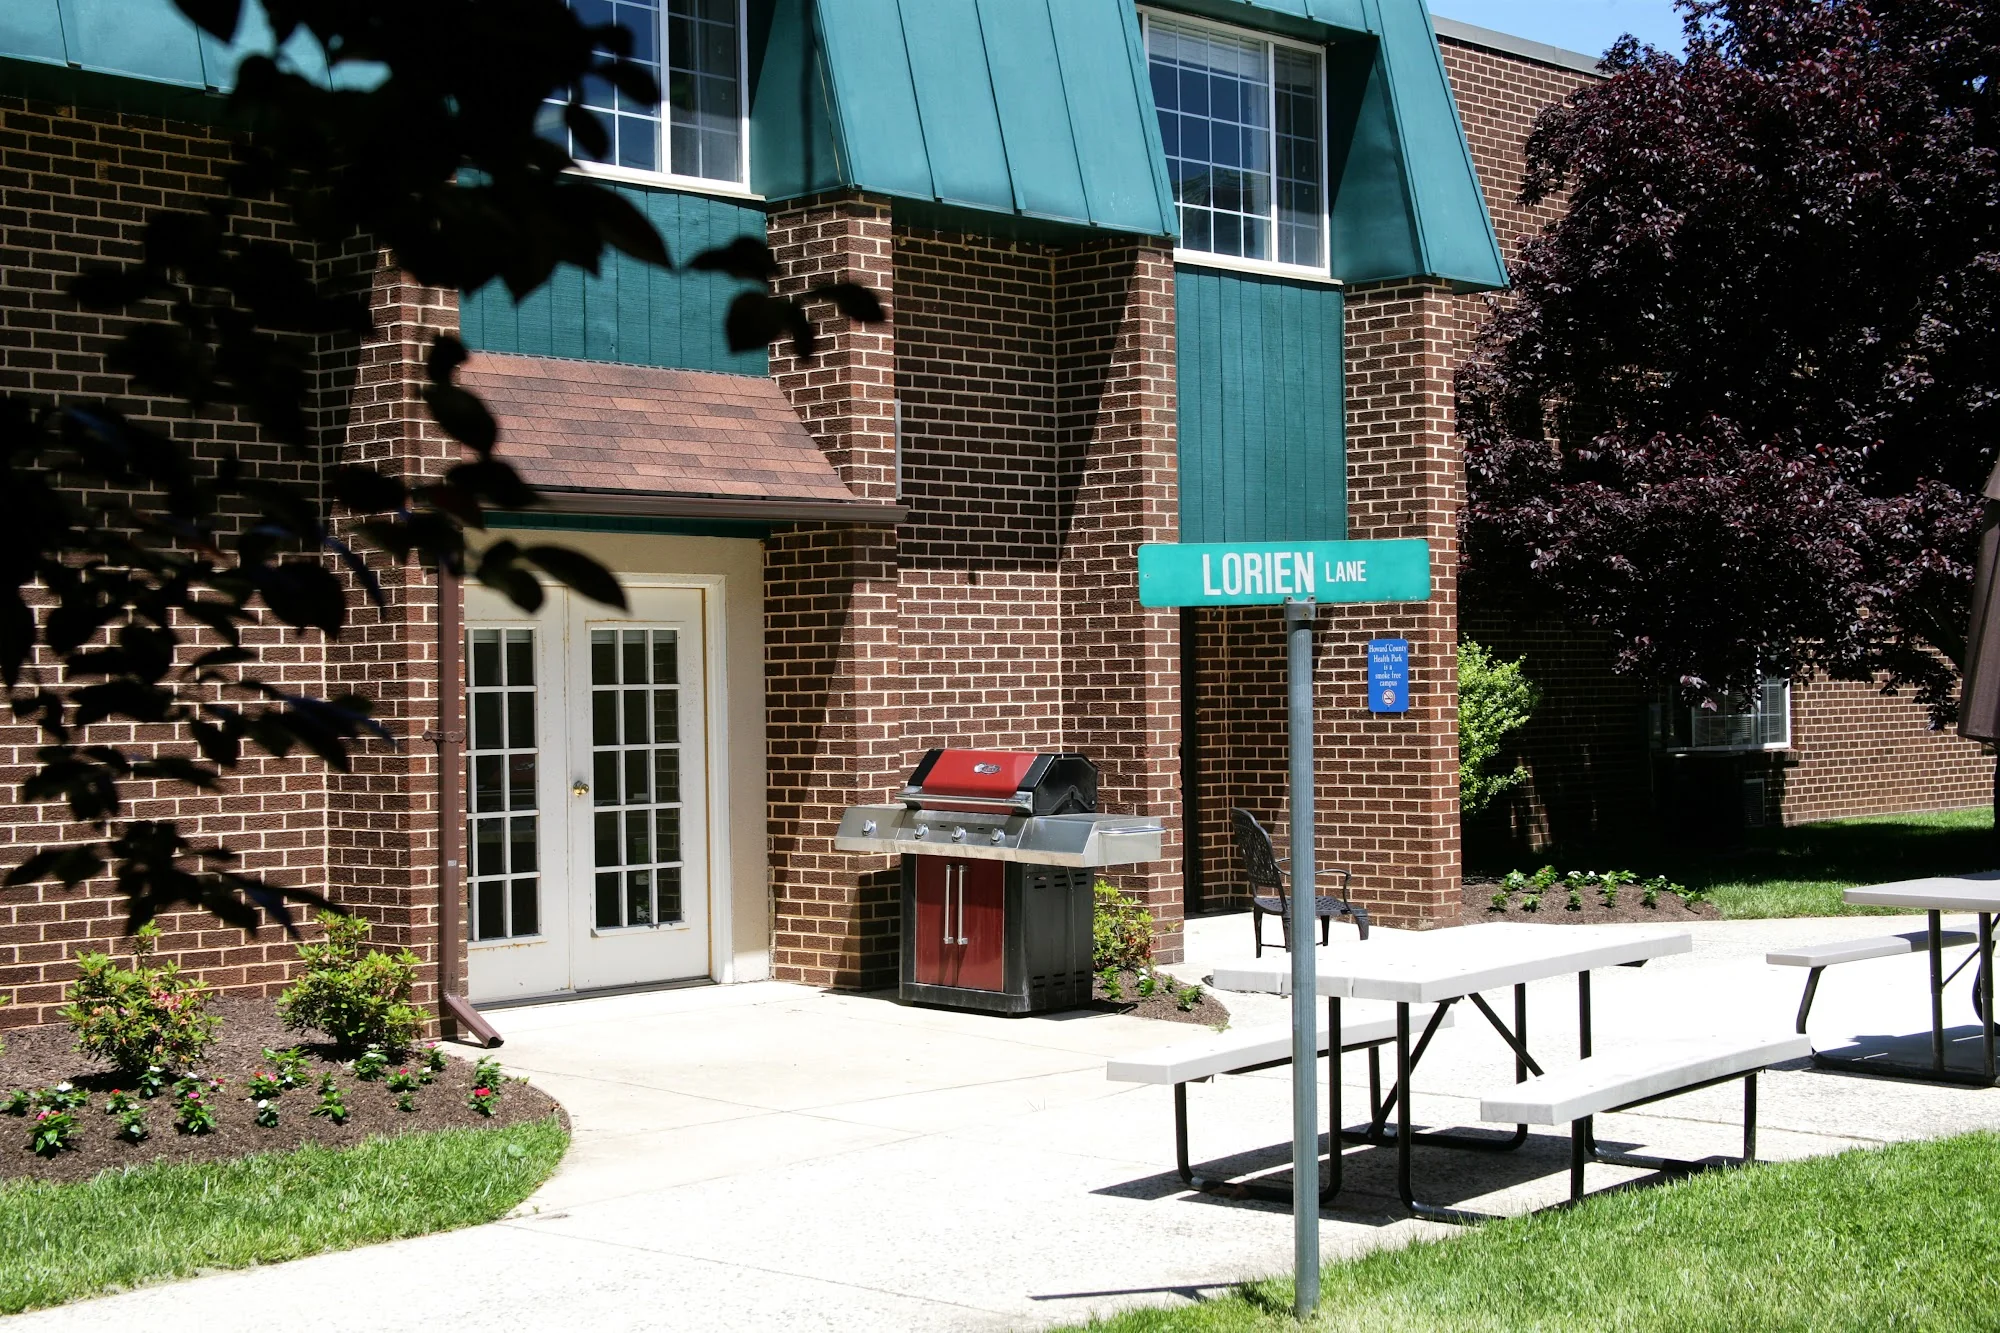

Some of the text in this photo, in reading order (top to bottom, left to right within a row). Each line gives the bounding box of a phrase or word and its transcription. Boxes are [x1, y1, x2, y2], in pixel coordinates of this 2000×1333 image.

[1202, 552, 1367, 596] LORIEN LANE
[1388, 644, 1406, 652] County
[1374, 654, 1402, 662] Health Park
[1375, 671, 1390, 679] smoke
